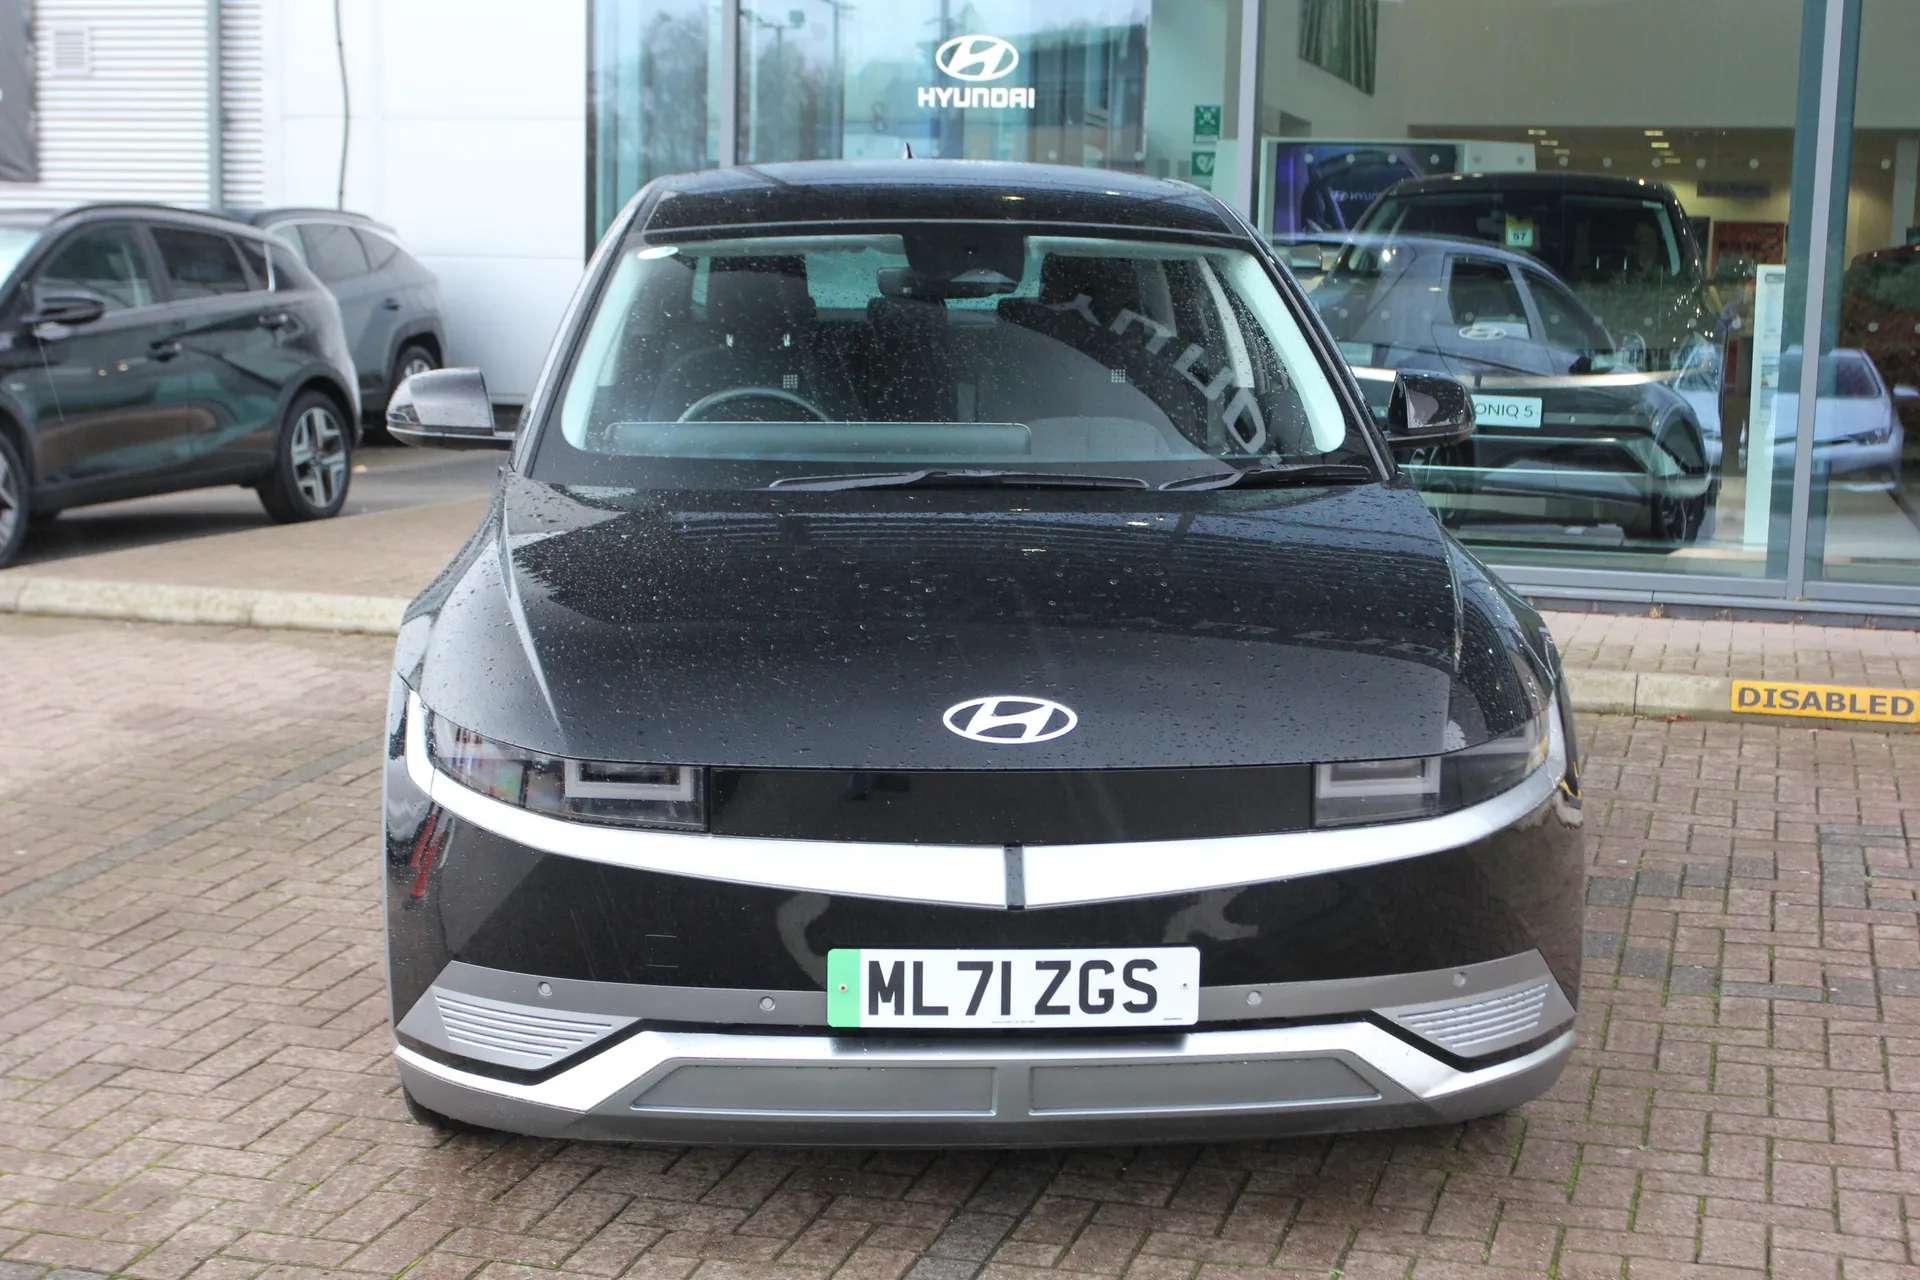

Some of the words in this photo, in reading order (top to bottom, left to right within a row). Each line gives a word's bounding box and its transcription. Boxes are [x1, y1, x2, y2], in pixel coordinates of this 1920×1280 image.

[917, 87, 1036, 109] HYUNDAI
[1474, 402, 1519, 420] ONIQ
[1524, 405, 1534, 419] 5
[1738, 686, 1915, 717] DISABLED
[867, 960, 1012, 1017] ML71
[1034, 958, 1158, 1015] ZGS
